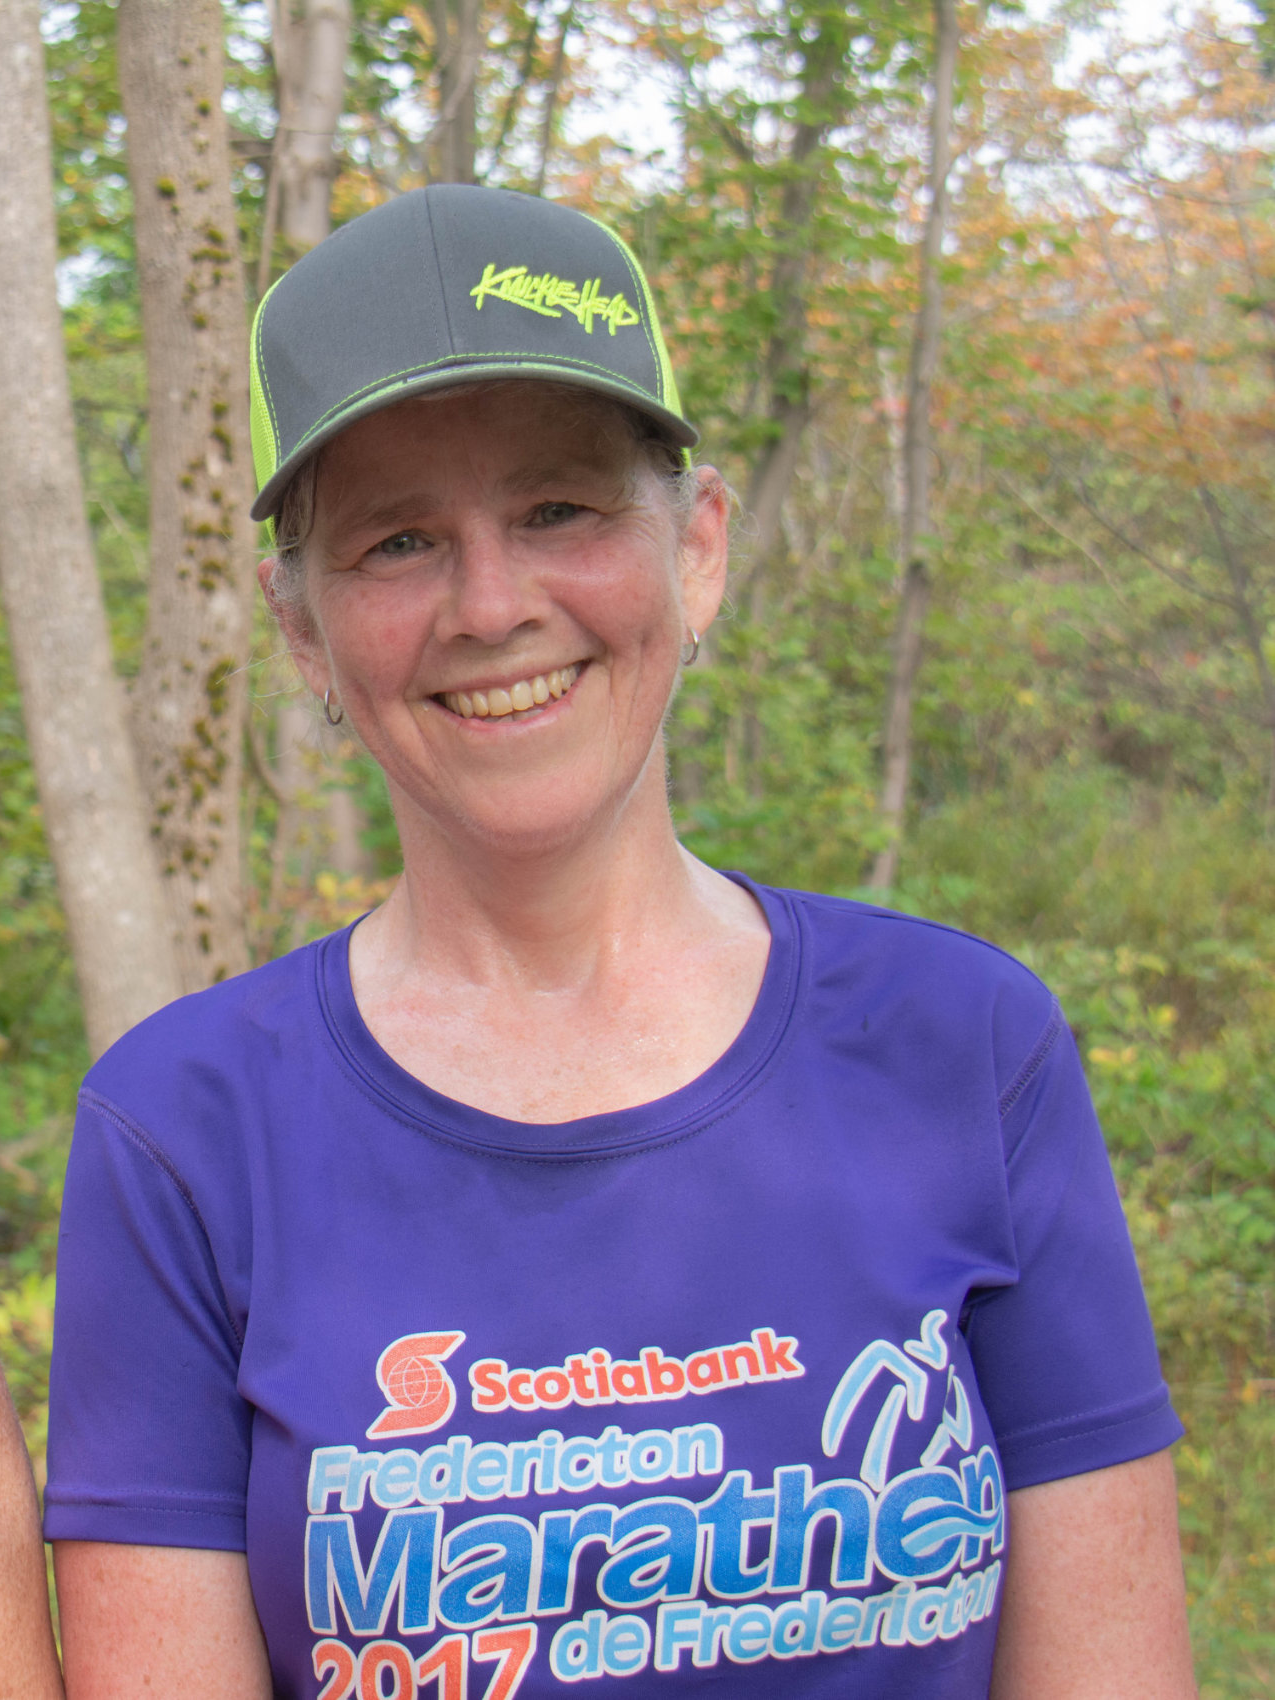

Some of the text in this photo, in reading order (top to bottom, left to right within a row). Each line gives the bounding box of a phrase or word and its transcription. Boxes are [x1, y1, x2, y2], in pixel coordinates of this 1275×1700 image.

[469, 1328, 805, 1412] Scotiabank
[309, 1423, 723, 1512] Fredericton
[305, 1445, 1005, 1636] Marathon
[312, 1622, 538, 1700] 2017
[550, 1560, 1002, 1680] de Fredericton
